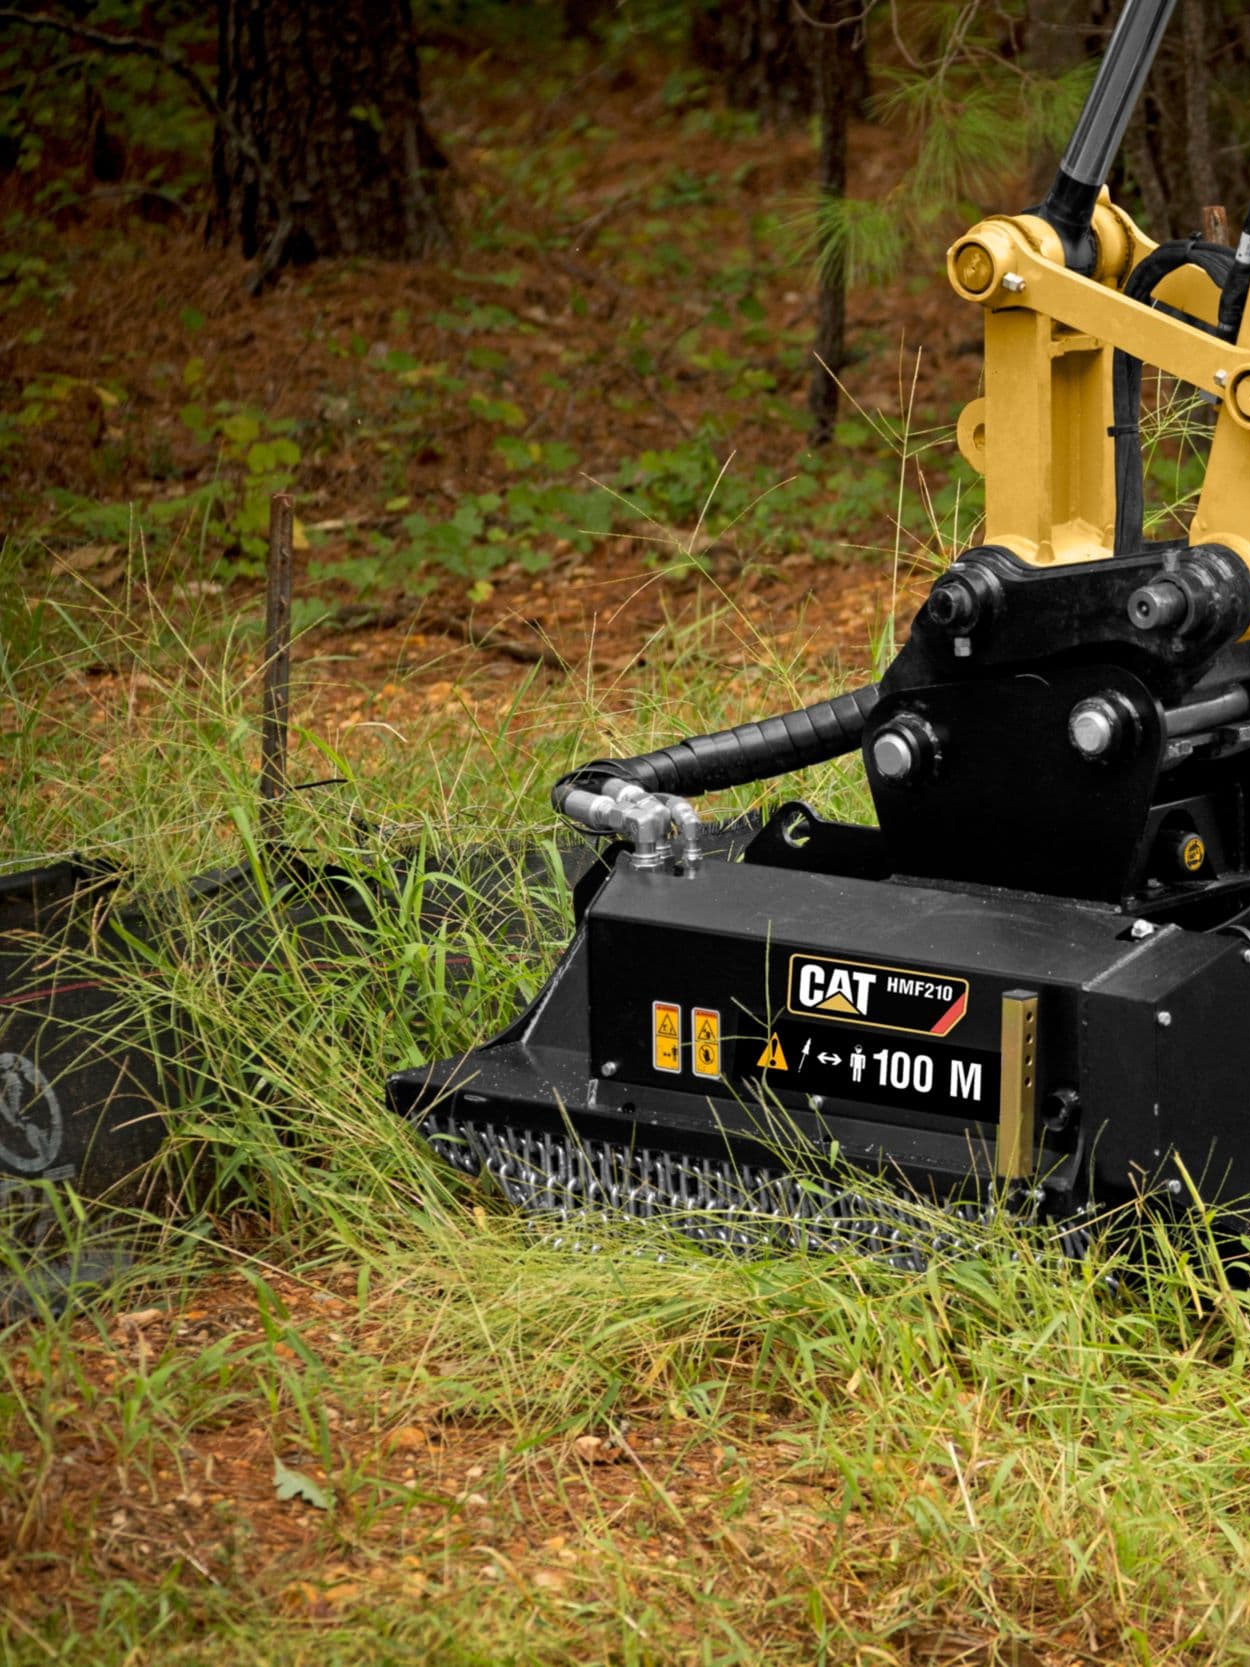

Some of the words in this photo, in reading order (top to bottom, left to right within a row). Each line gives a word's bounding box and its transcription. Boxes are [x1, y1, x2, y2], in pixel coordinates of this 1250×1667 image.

[799, 964, 877, 1016] CAT
[886, 976, 953, 1002] HMF210
[873, 1049, 933, 1093] 100
[950, 1059, 982, 1101] M
